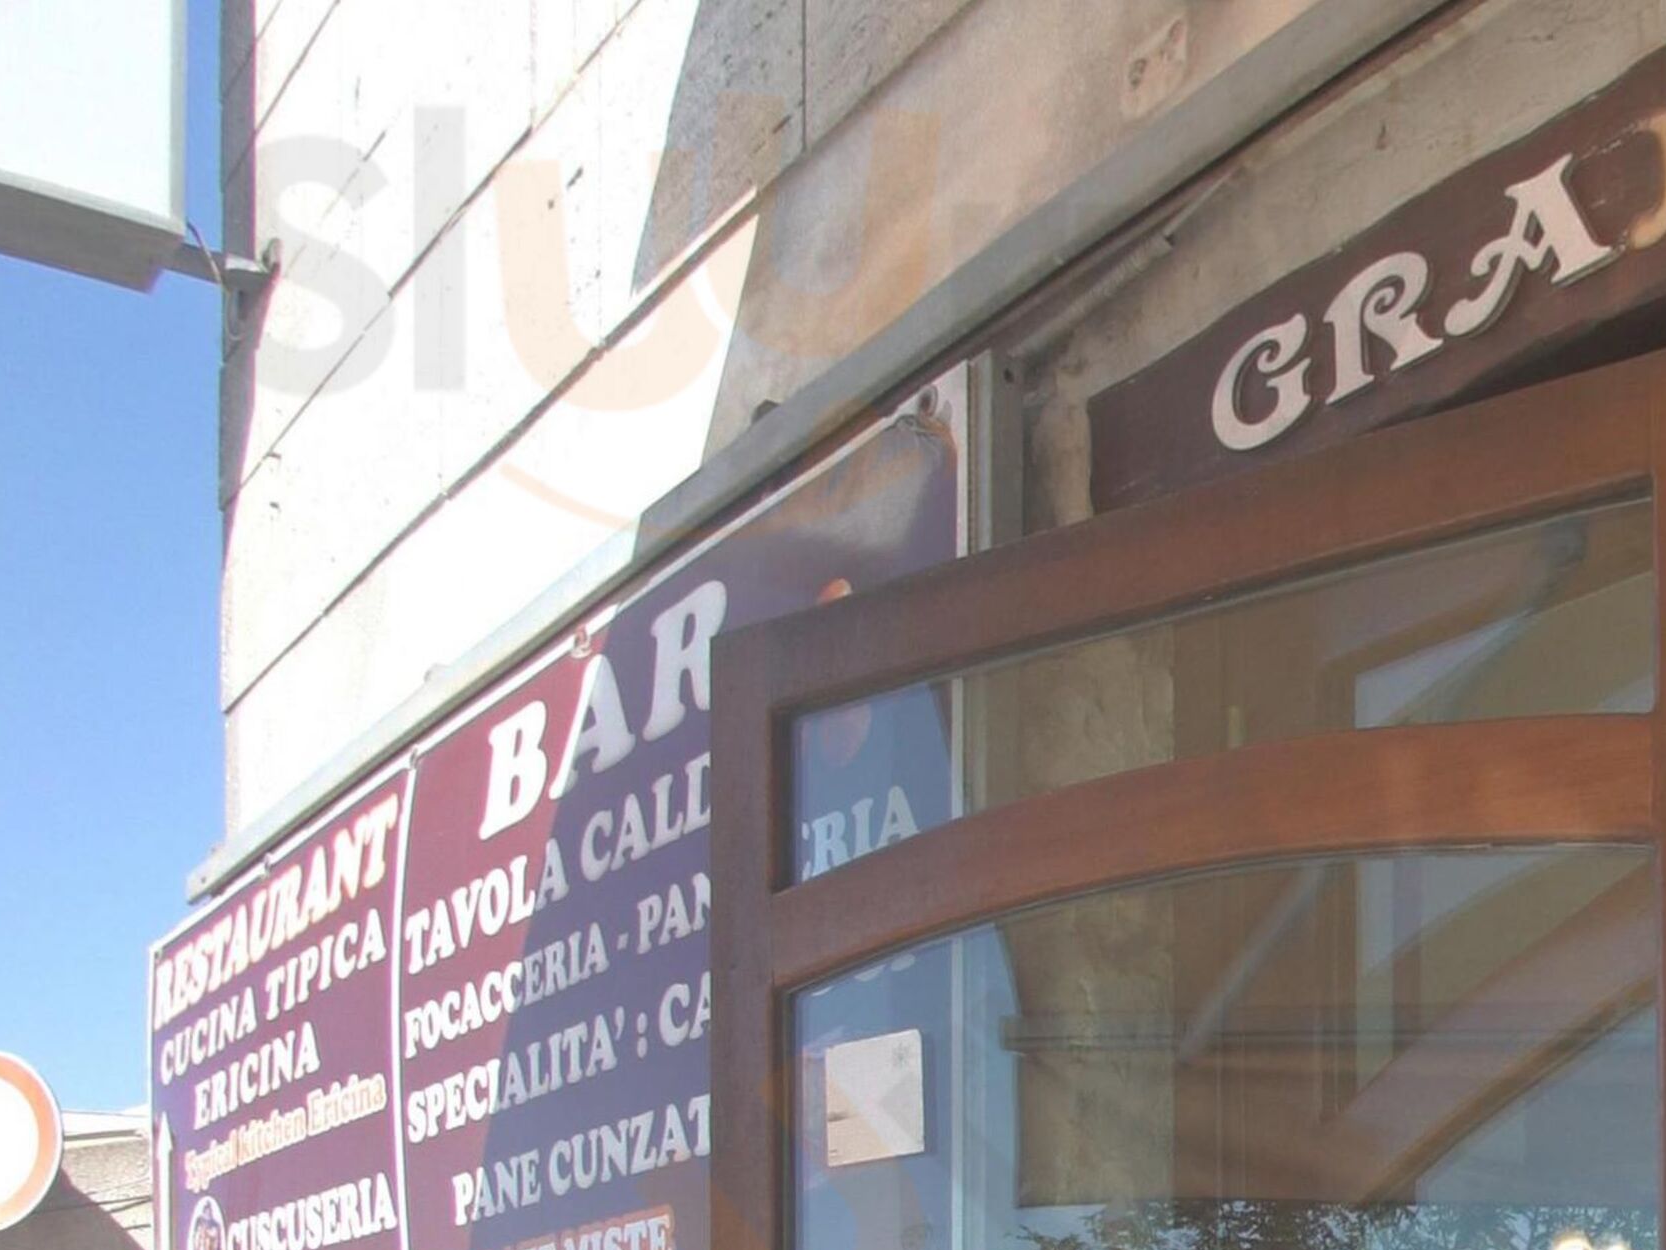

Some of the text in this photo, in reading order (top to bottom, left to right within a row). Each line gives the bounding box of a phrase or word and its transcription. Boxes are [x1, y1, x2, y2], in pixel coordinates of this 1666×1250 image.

[478, 579, 728, 841] BAR
[153, 793, 399, 1032] RESTAURANT
[404, 751, 712, 975] TAVOLA CALD
[160, 908, 388, 1085] CUCINA TIPICA
[404, 921, 610, 1060] FOCACCERIA
[194, 1021, 321, 1131] ERICINA
[307, 1072, 388, 1137] Ericina
[451, 1094, 712, 1226] PANE CUNZAT
